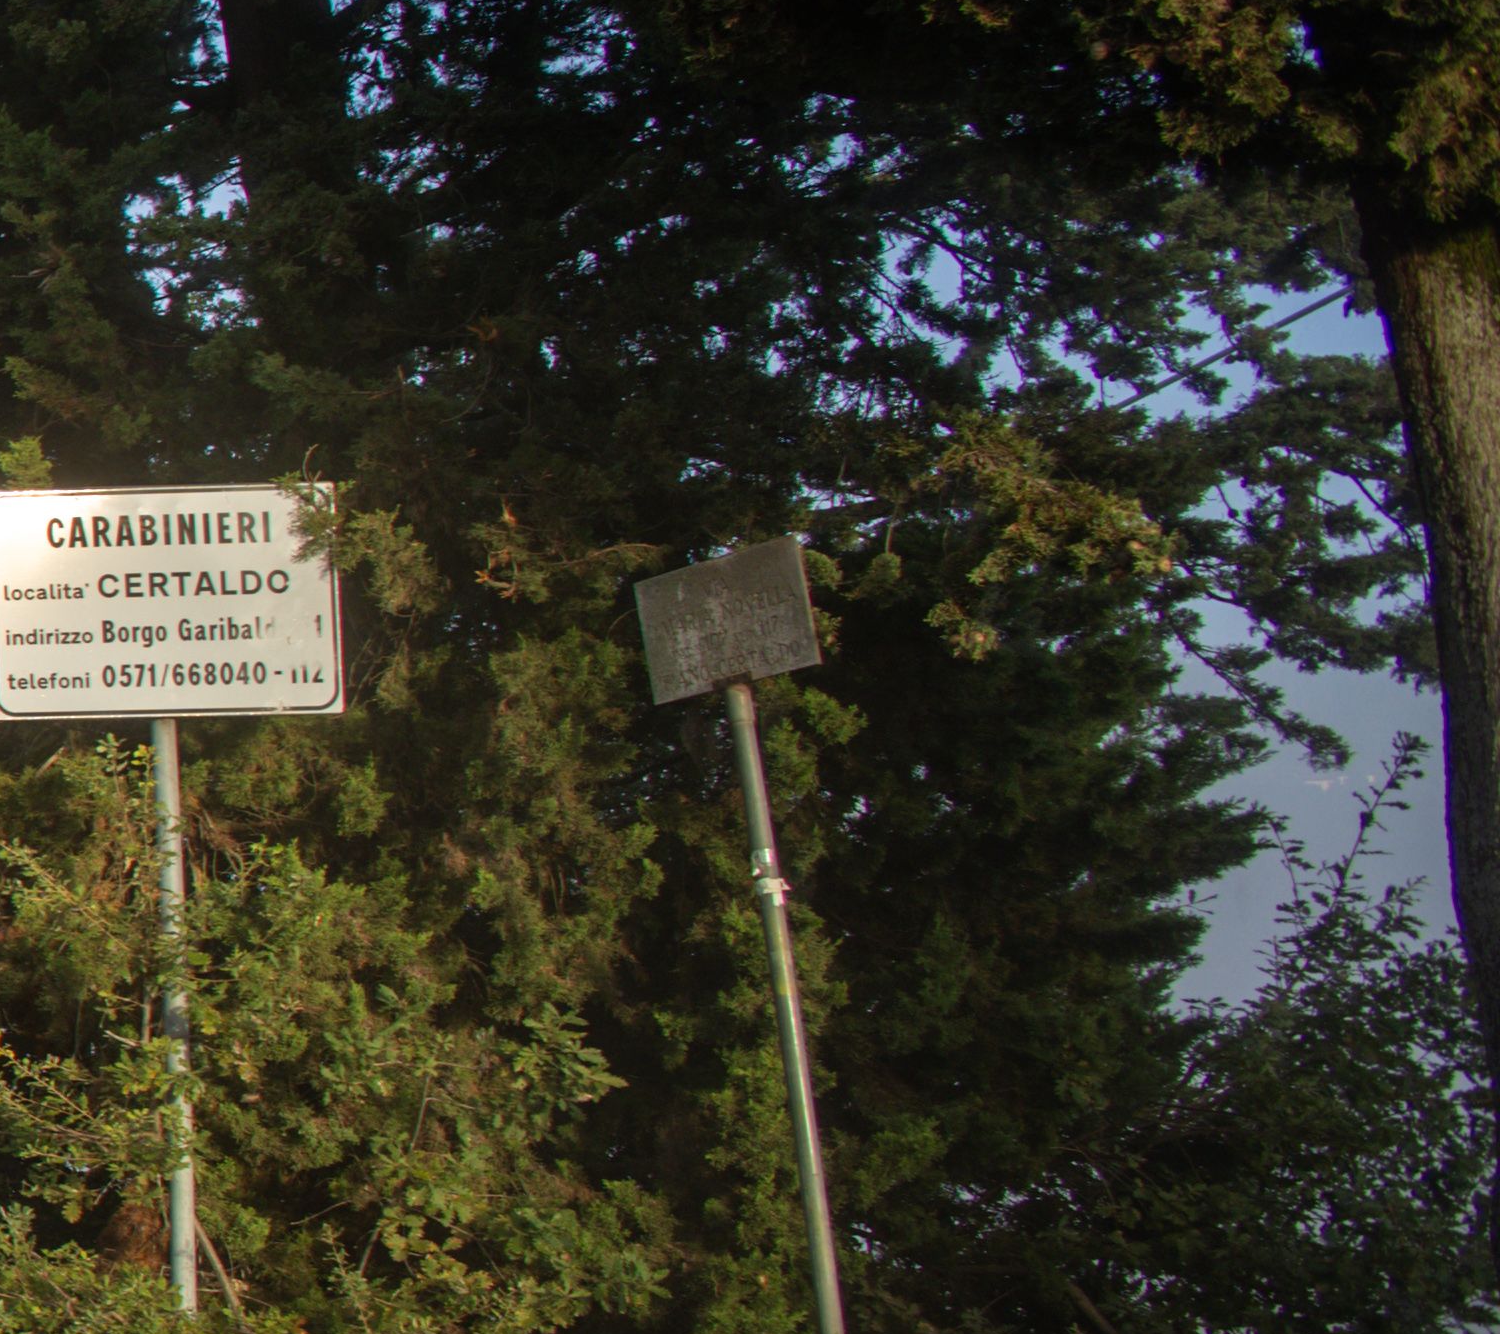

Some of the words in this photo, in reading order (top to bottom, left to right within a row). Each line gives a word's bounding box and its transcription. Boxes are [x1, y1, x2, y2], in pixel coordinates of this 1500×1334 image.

[47, 511, 271, 548] CARABINIERI
[98, 570, 290, 598] CERTALDO
[6, 629, 94, 646] indirizzo
[102, 620, 167, 647] Borgo
[7, 673, 91, 690] telefoni
[102, 661, 267, 688] 0571/668040
